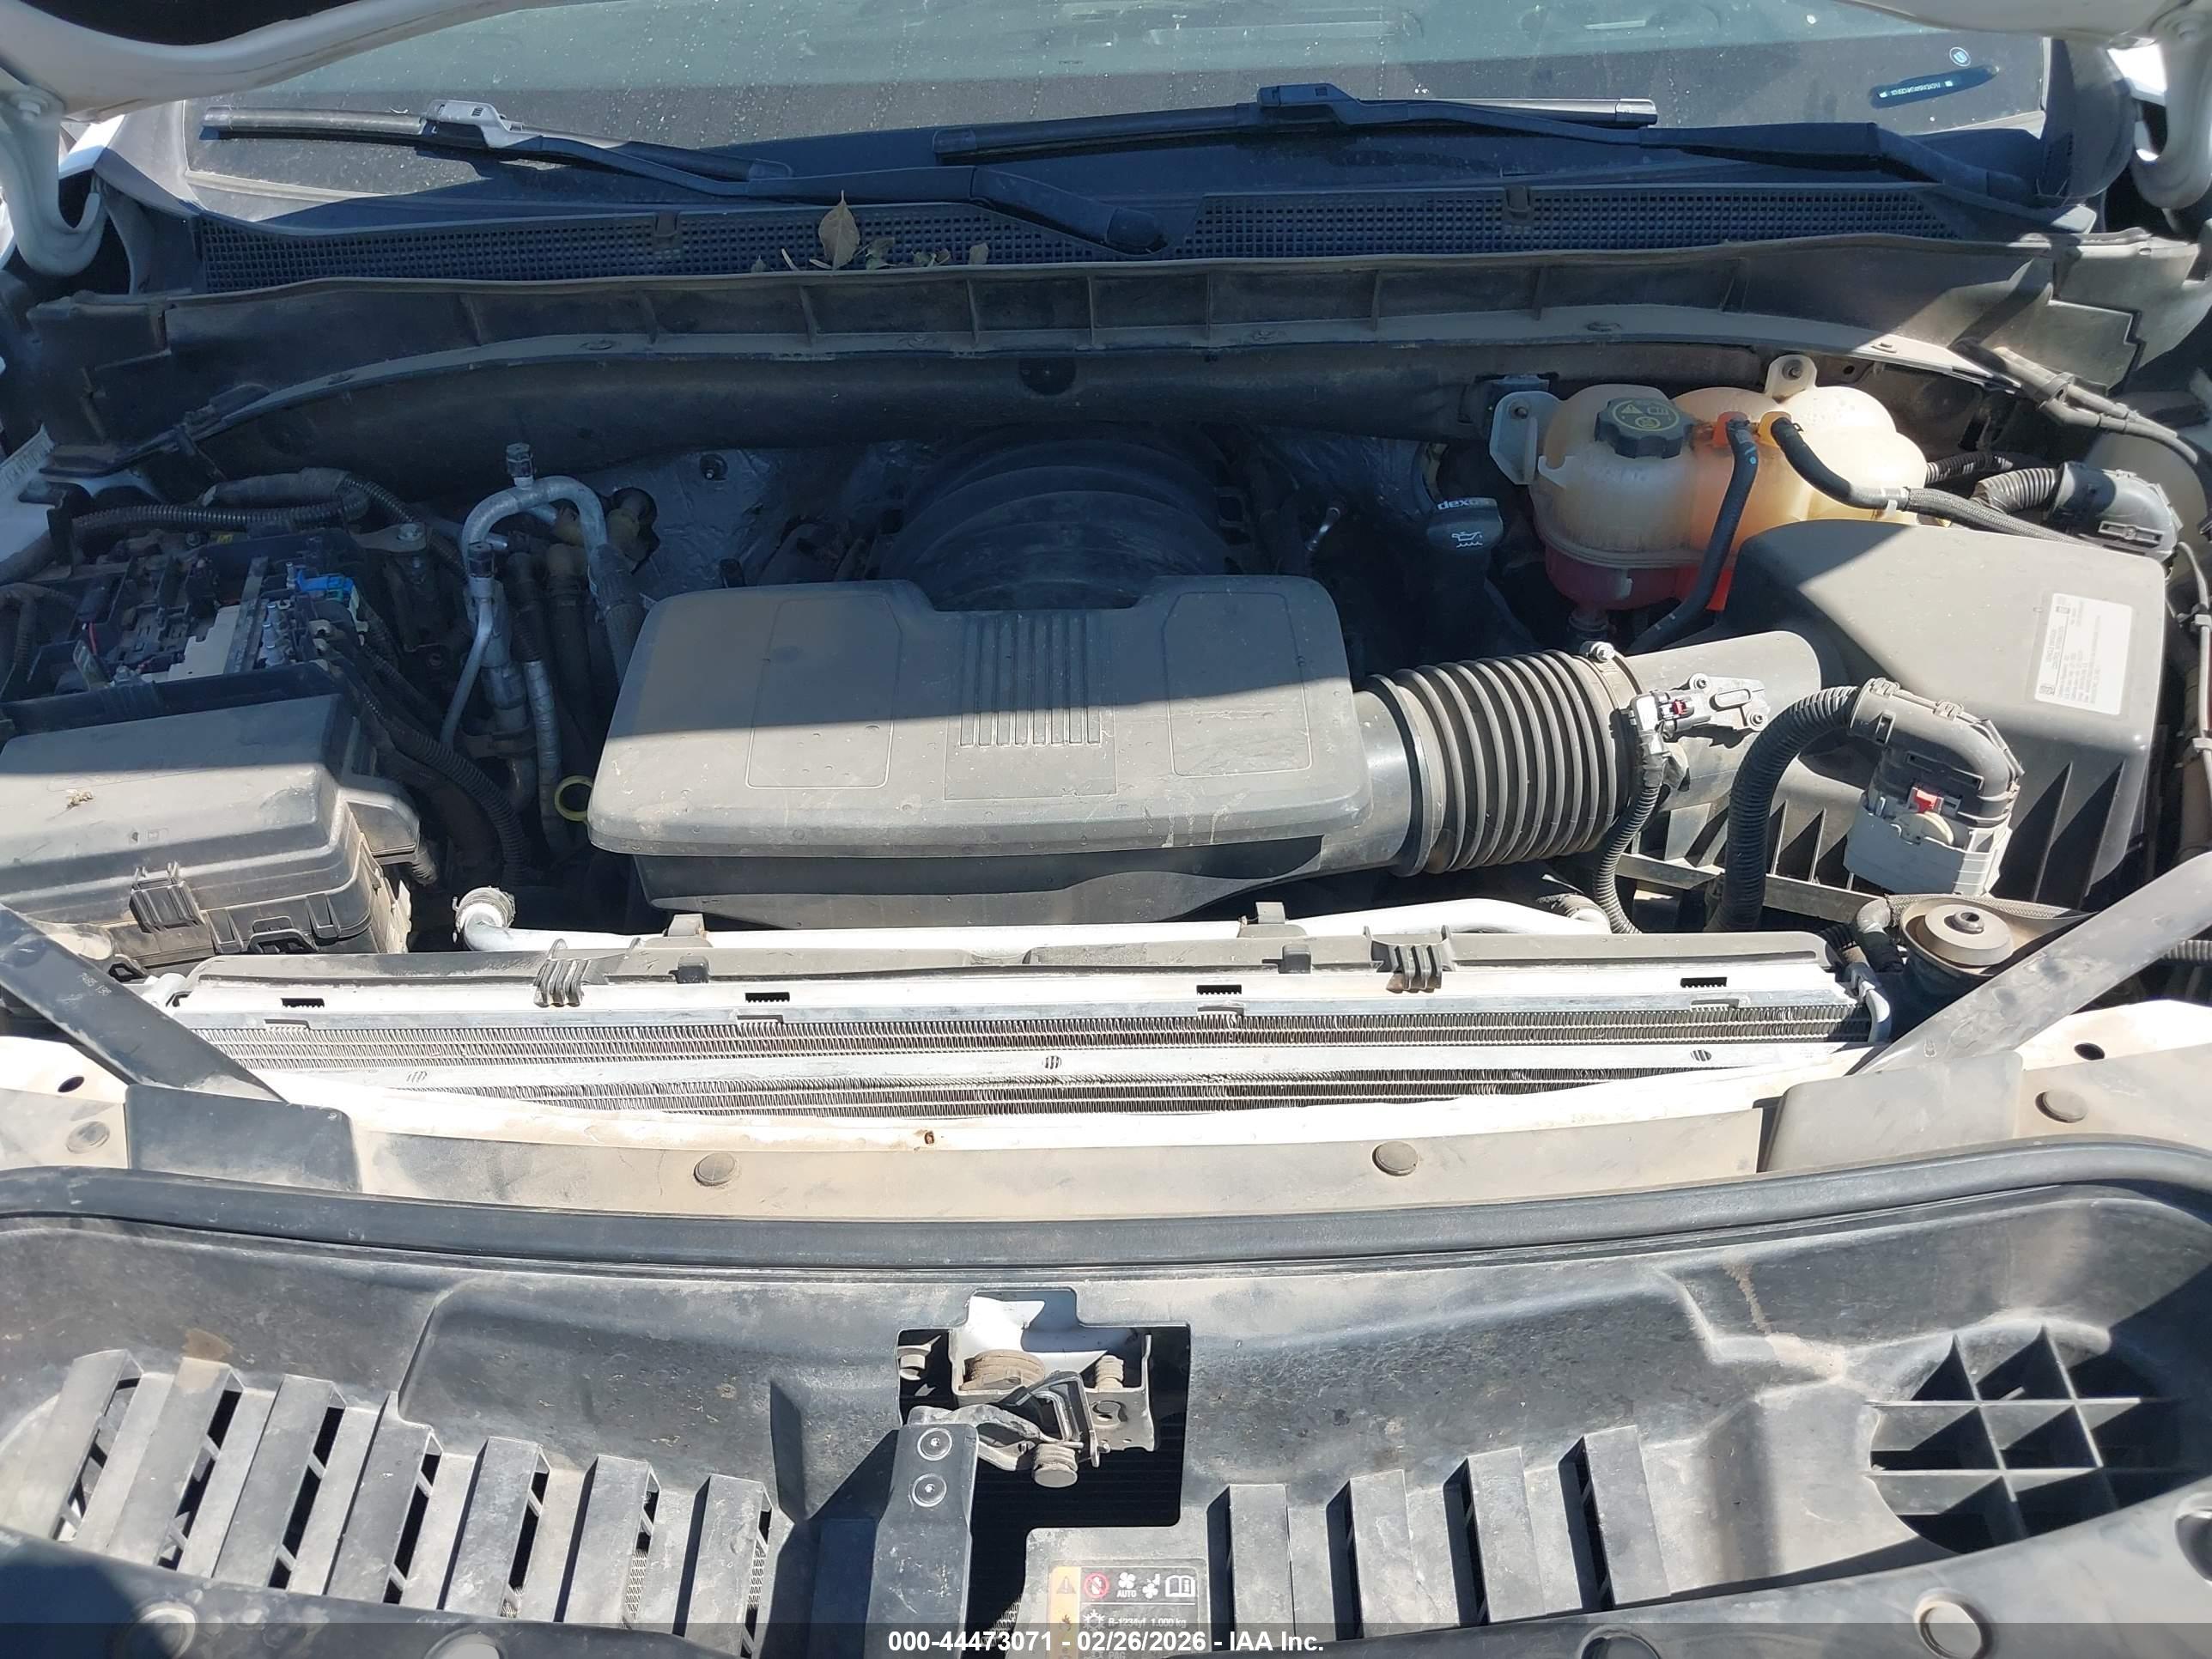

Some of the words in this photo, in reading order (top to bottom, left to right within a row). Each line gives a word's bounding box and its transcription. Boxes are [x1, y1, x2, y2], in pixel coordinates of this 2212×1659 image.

[1116, 1589, 1137, 1598] AUTO
[1108, 1617, 1146, 1629] R-1234yf
[1151, 1617, 1175, 1627] 1.000
[1176, 1617, 1187, 1629] kg
